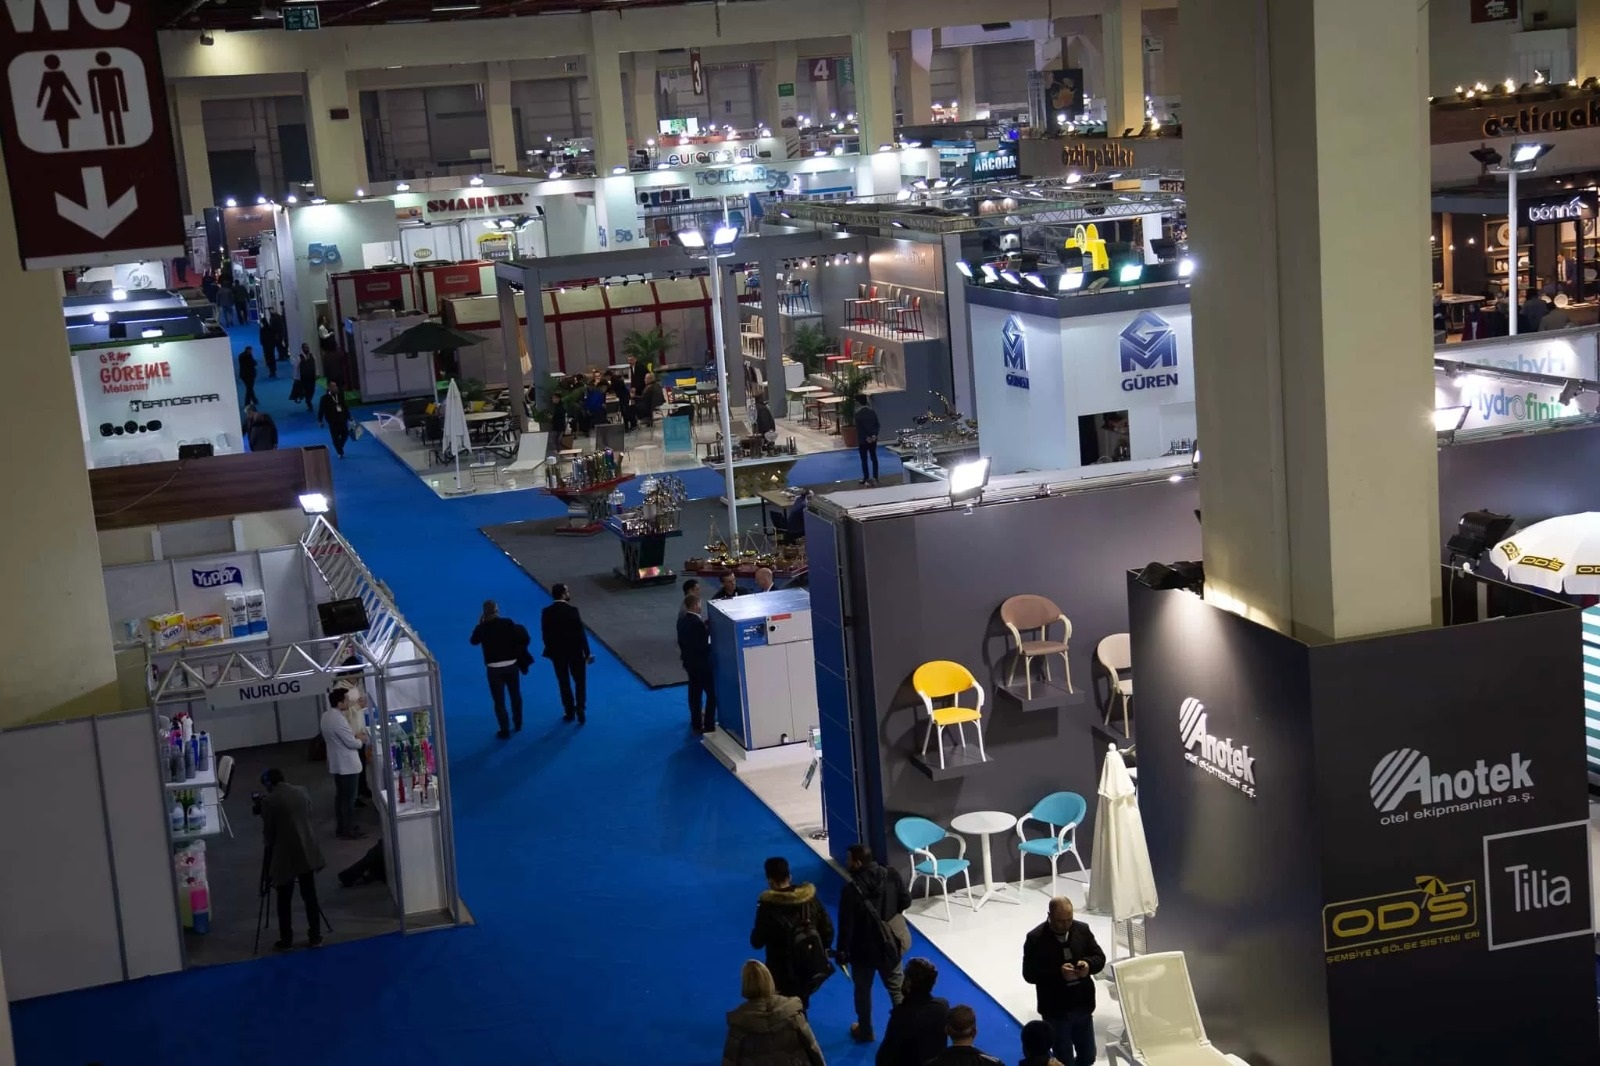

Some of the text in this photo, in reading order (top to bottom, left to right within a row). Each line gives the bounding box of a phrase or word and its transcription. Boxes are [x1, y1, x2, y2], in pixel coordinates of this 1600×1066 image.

[693, 60, 701, 94] 3
[813, 59, 830, 80] 4
[974, 155, 1016, 172] ARCORA
[427, 192, 524, 213] SMARTEX
[103, 381, 149, 395] Melamin
[1121, 373, 1178, 391] GÜREN
[1521, 555, 1562, 570] ODS
[239, 680, 301, 701] NURLOG
[1184, 712, 1256, 785] Anotek
[1380, 752, 1535, 813] Anotek
[1380, 811, 1409, 826] otel
[1413, 797, 1503, 820] ekipmanları
[1505, 863, 1571, 913] Tilia
